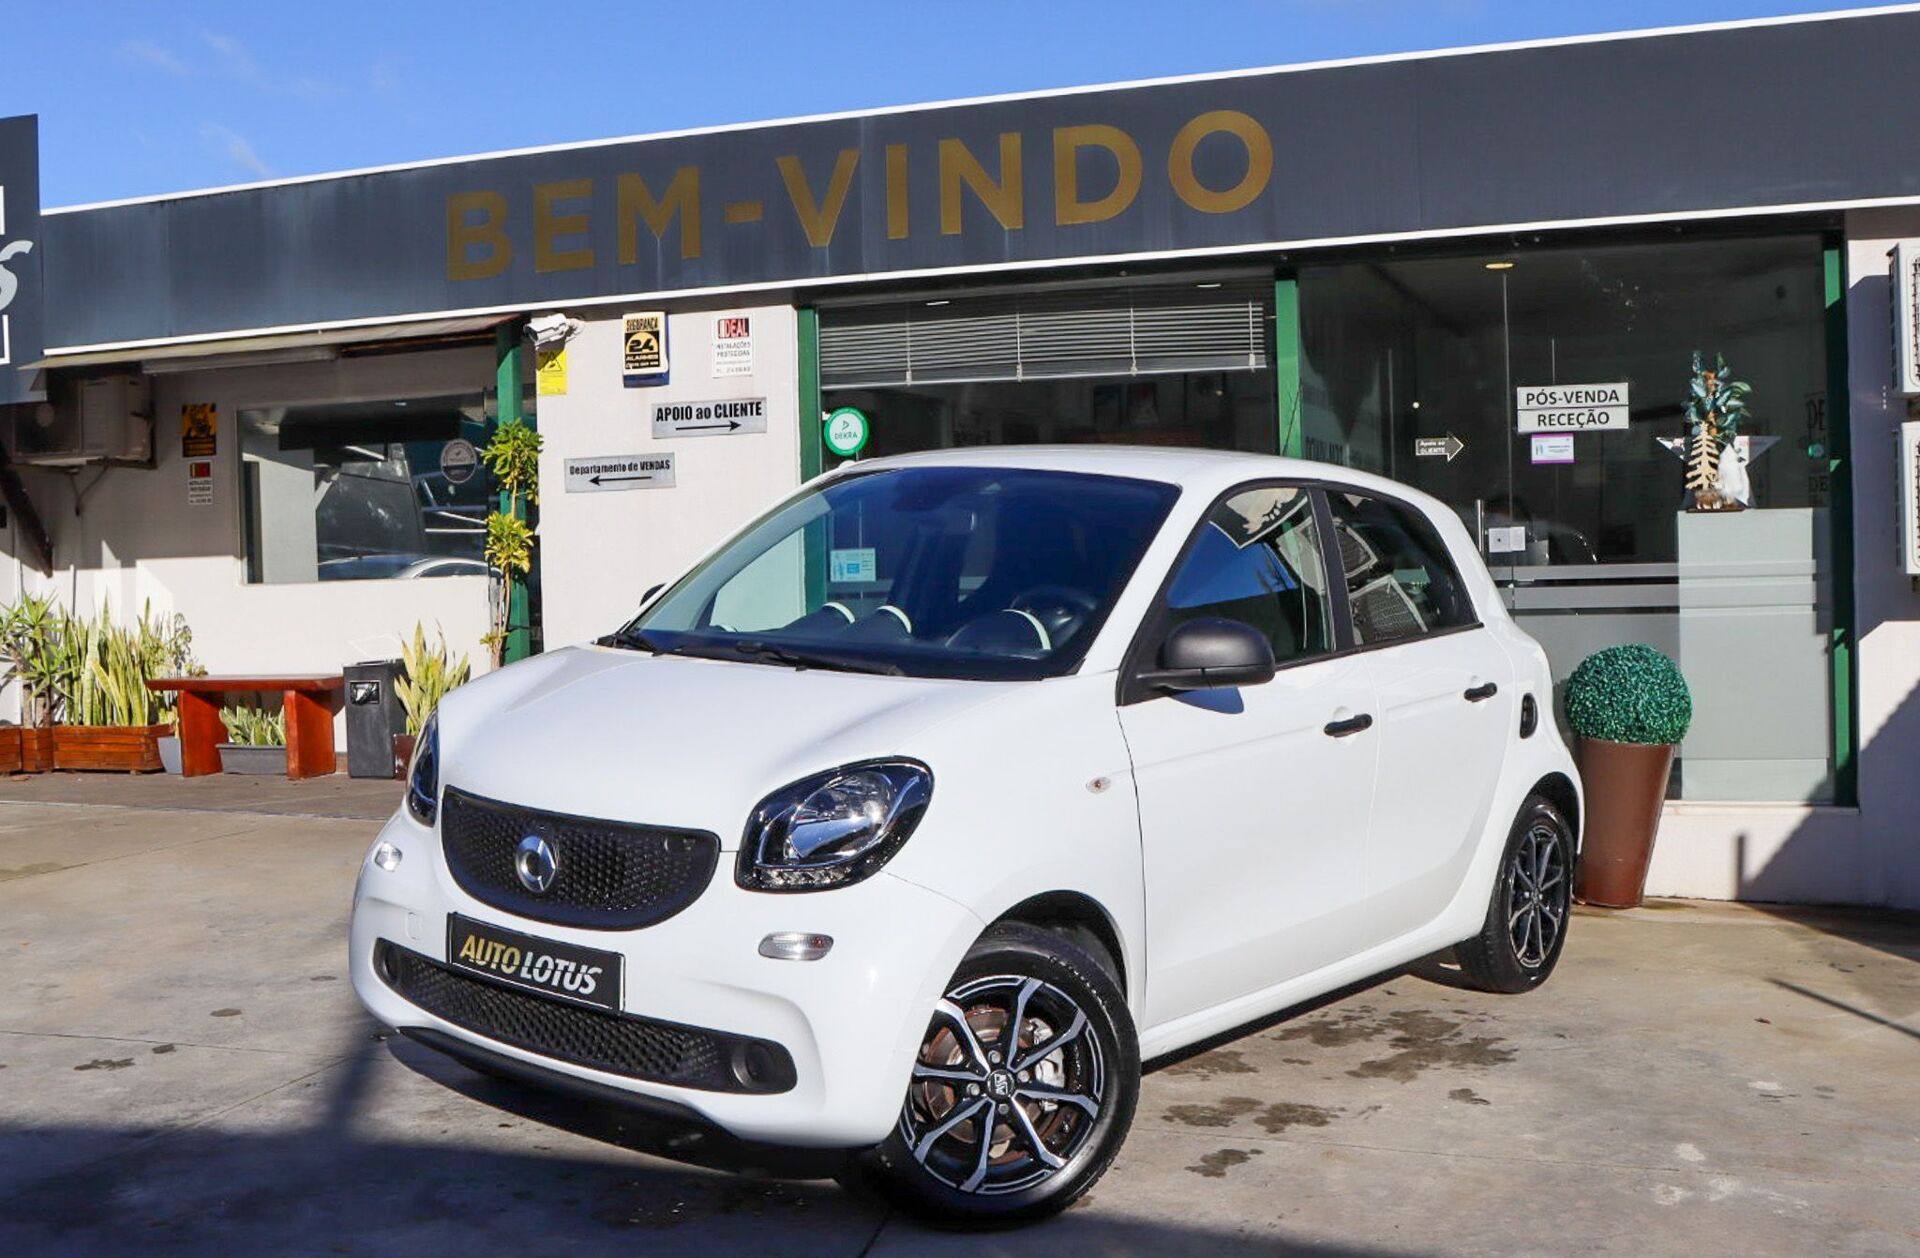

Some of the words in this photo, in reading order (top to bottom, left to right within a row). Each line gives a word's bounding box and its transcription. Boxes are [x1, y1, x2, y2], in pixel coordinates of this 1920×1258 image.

[445, 109, 1275, 282] BEM-VINDO
[718, 319, 749, 338] IDEAL
[1526, 389, 1620, 406] PÓS-VENDA
[656, 405, 693, 422] APOIO
[696, 407, 712, 420] ao
[714, 401, 762, 419] CLIENTE
[1538, 408, 1610, 429] RECEÇÃO
[569, 463, 627, 476] Departamento
[628, 461, 639, 472] de
[640, 459, 671, 471] VENDAS
[459, 934, 521, 975] AUTO
[520, 951, 604, 995] LOTUS
